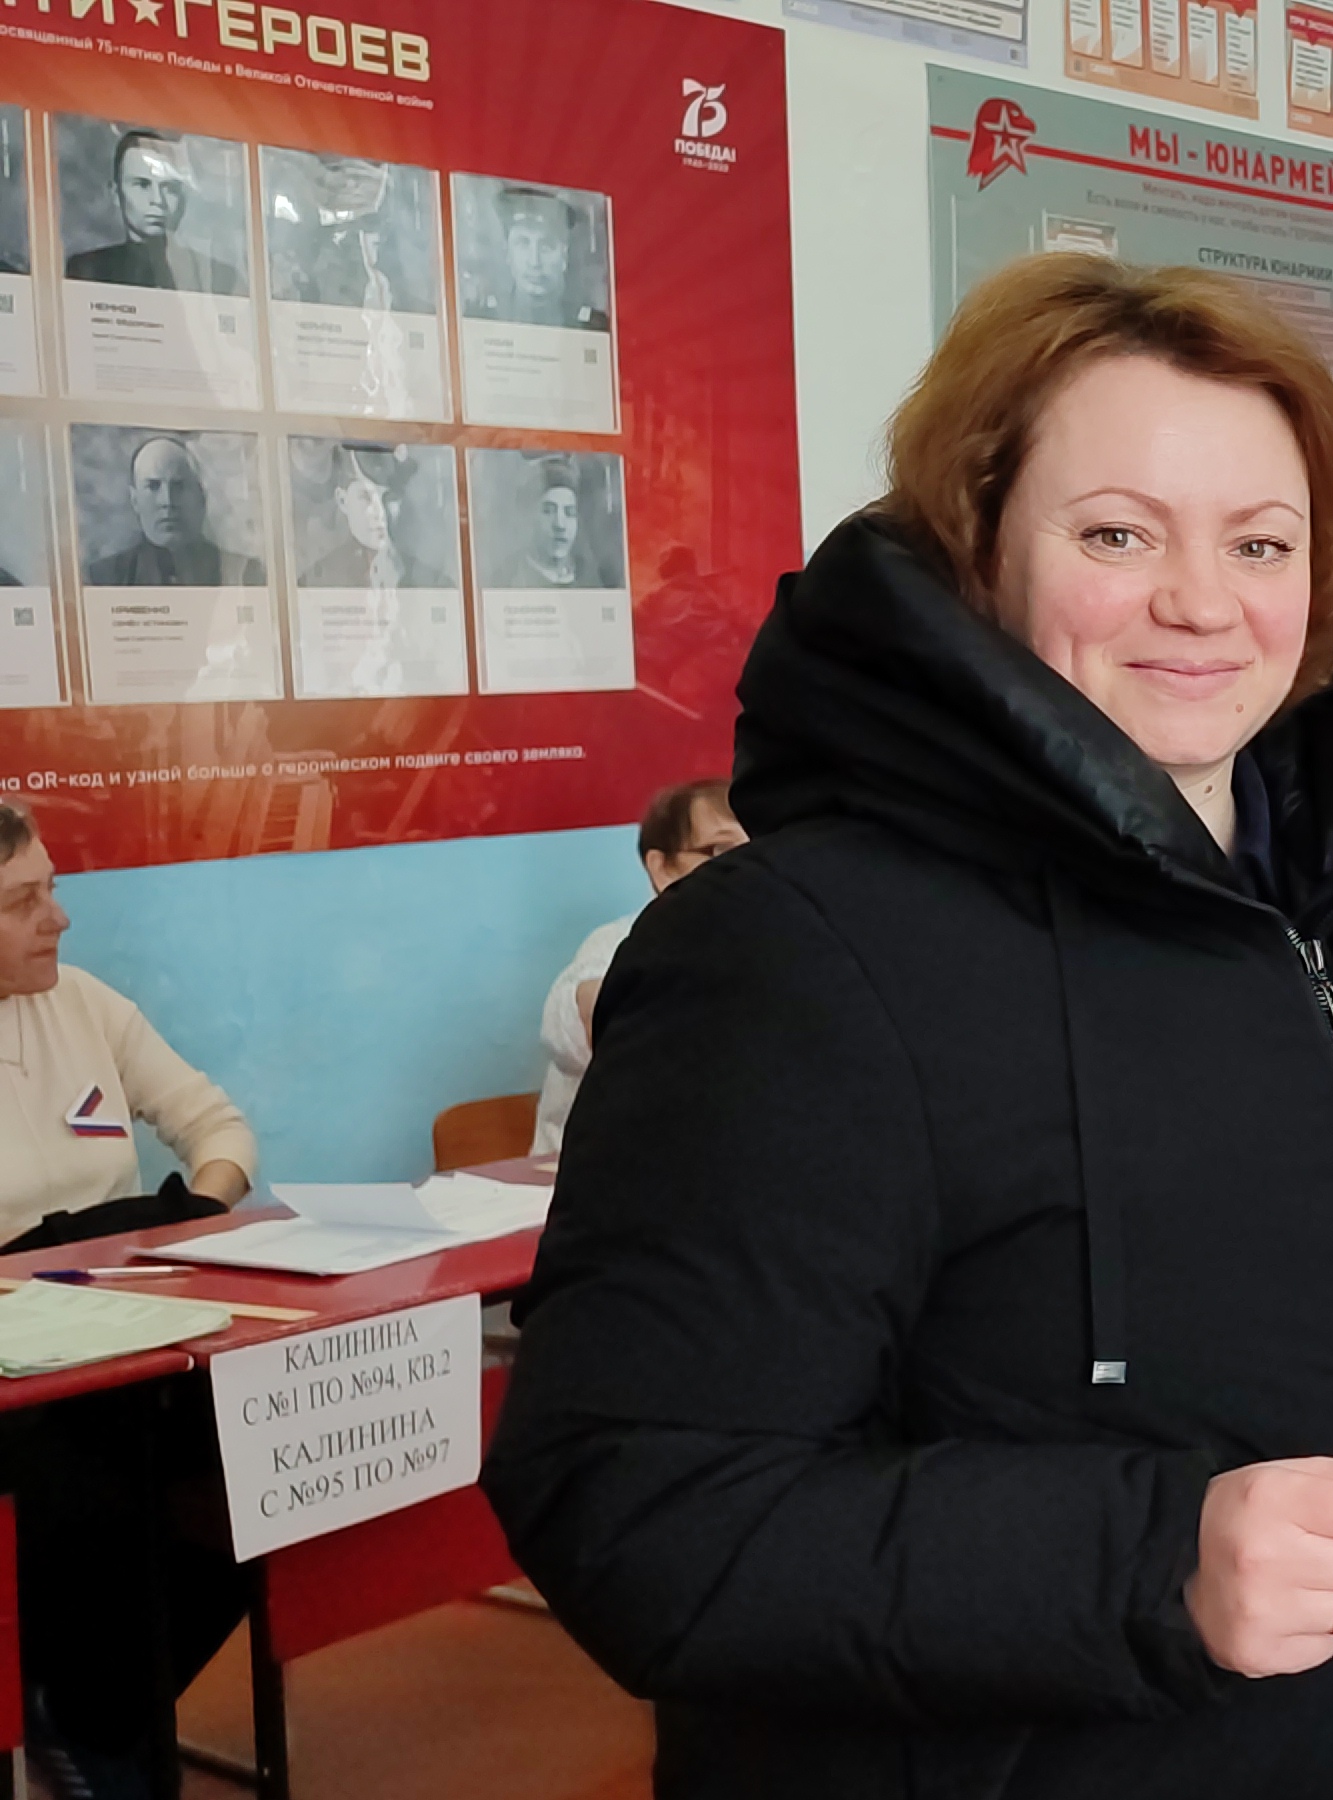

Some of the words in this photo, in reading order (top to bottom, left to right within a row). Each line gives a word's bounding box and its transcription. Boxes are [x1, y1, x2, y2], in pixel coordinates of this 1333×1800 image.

[96, 38, 164, 63] 75-летию
[167, 52, 221, 73] Победы
[235, 63, 291, 85] Великой
[294, 74, 394, 103] Отечественной
[173, 0, 430, 82] ГЕРОЕВ
[682, 77, 727, 138] 75
[674, 138, 737, 163] ПОБЕДА!
[1128, 123, 1179, 165] МЫ
[1198, 247, 1268, 273] СТРУКТУРА
[1271, 258, 1333, 282] ЮНАРМИИ
[27, 771, 104, 790] QR-код
[110, 772, 120, 785] и
[126, 766, 181, 788] узнай
[187, 763, 256, 781] больше
[261, 764, 272, 776] о
[278, 755, 390, 775] героическом
[395, 751, 460, 769] подвиге
[464, 748, 518, 766] своего
[284, 1317, 420, 1374] КАЛИНИНА
[242, 1397, 258, 1426] С
[265, 1388, 300, 1421] №1
[308, 1375, 343, 1410] ПО
[350, 1362, 402, 1400] №94,
[407, 1349, 451, 1384] КВ.2
[272, 1406, 436, 1475] КАЛИНИНА
[259, 1489, 279, 1519] С
[287, 1470, 344, 1513] №95
[353, 1456, 394, 1491] ПО
[400, 1438, 451, 1478] №97
